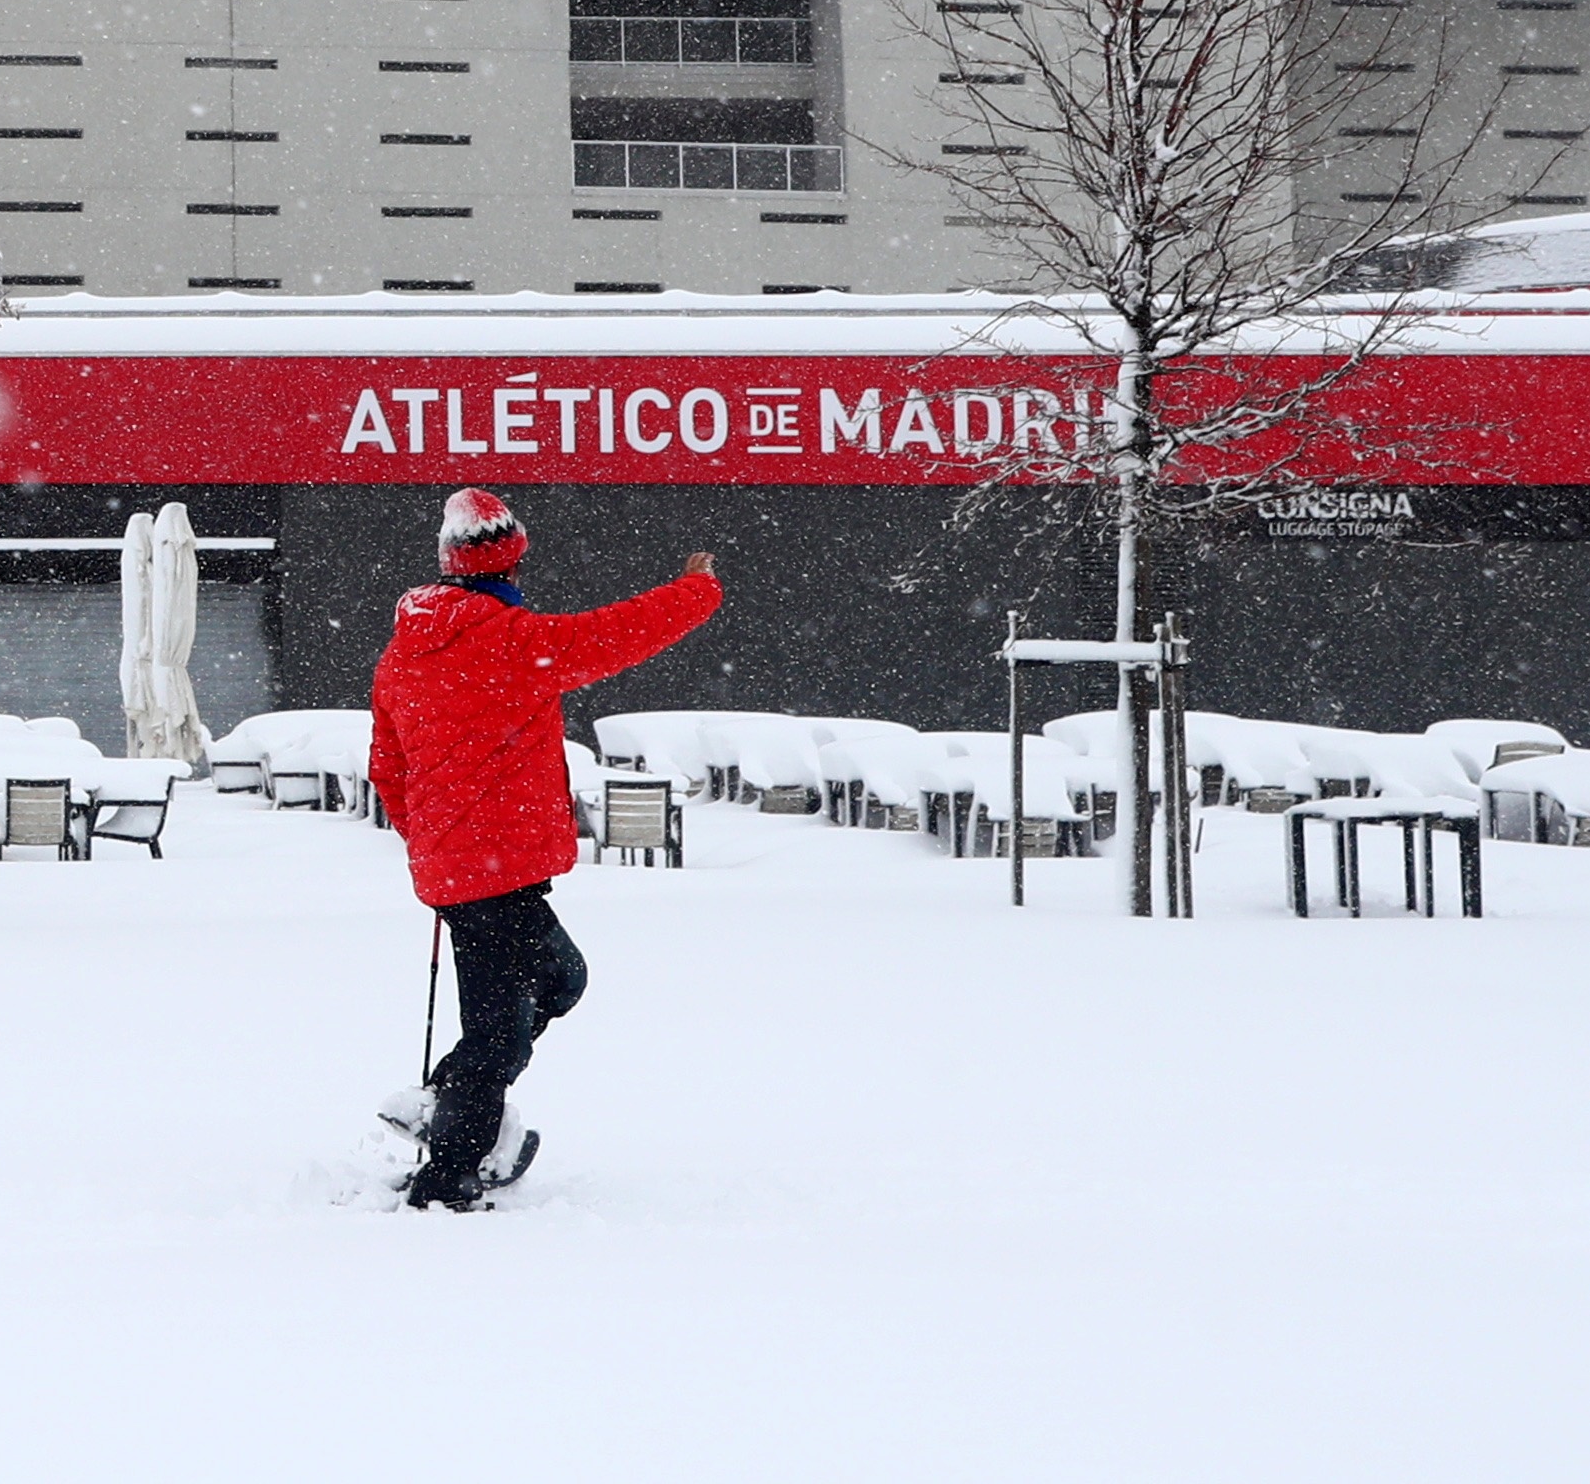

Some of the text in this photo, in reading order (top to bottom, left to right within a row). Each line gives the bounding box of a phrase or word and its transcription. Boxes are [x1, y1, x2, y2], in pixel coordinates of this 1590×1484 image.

[340, 372, 729, 454] ATLÉTICO
[750, 404, 800, 437] DE
[1269, 522, 1336, 537] LUGGAGE
